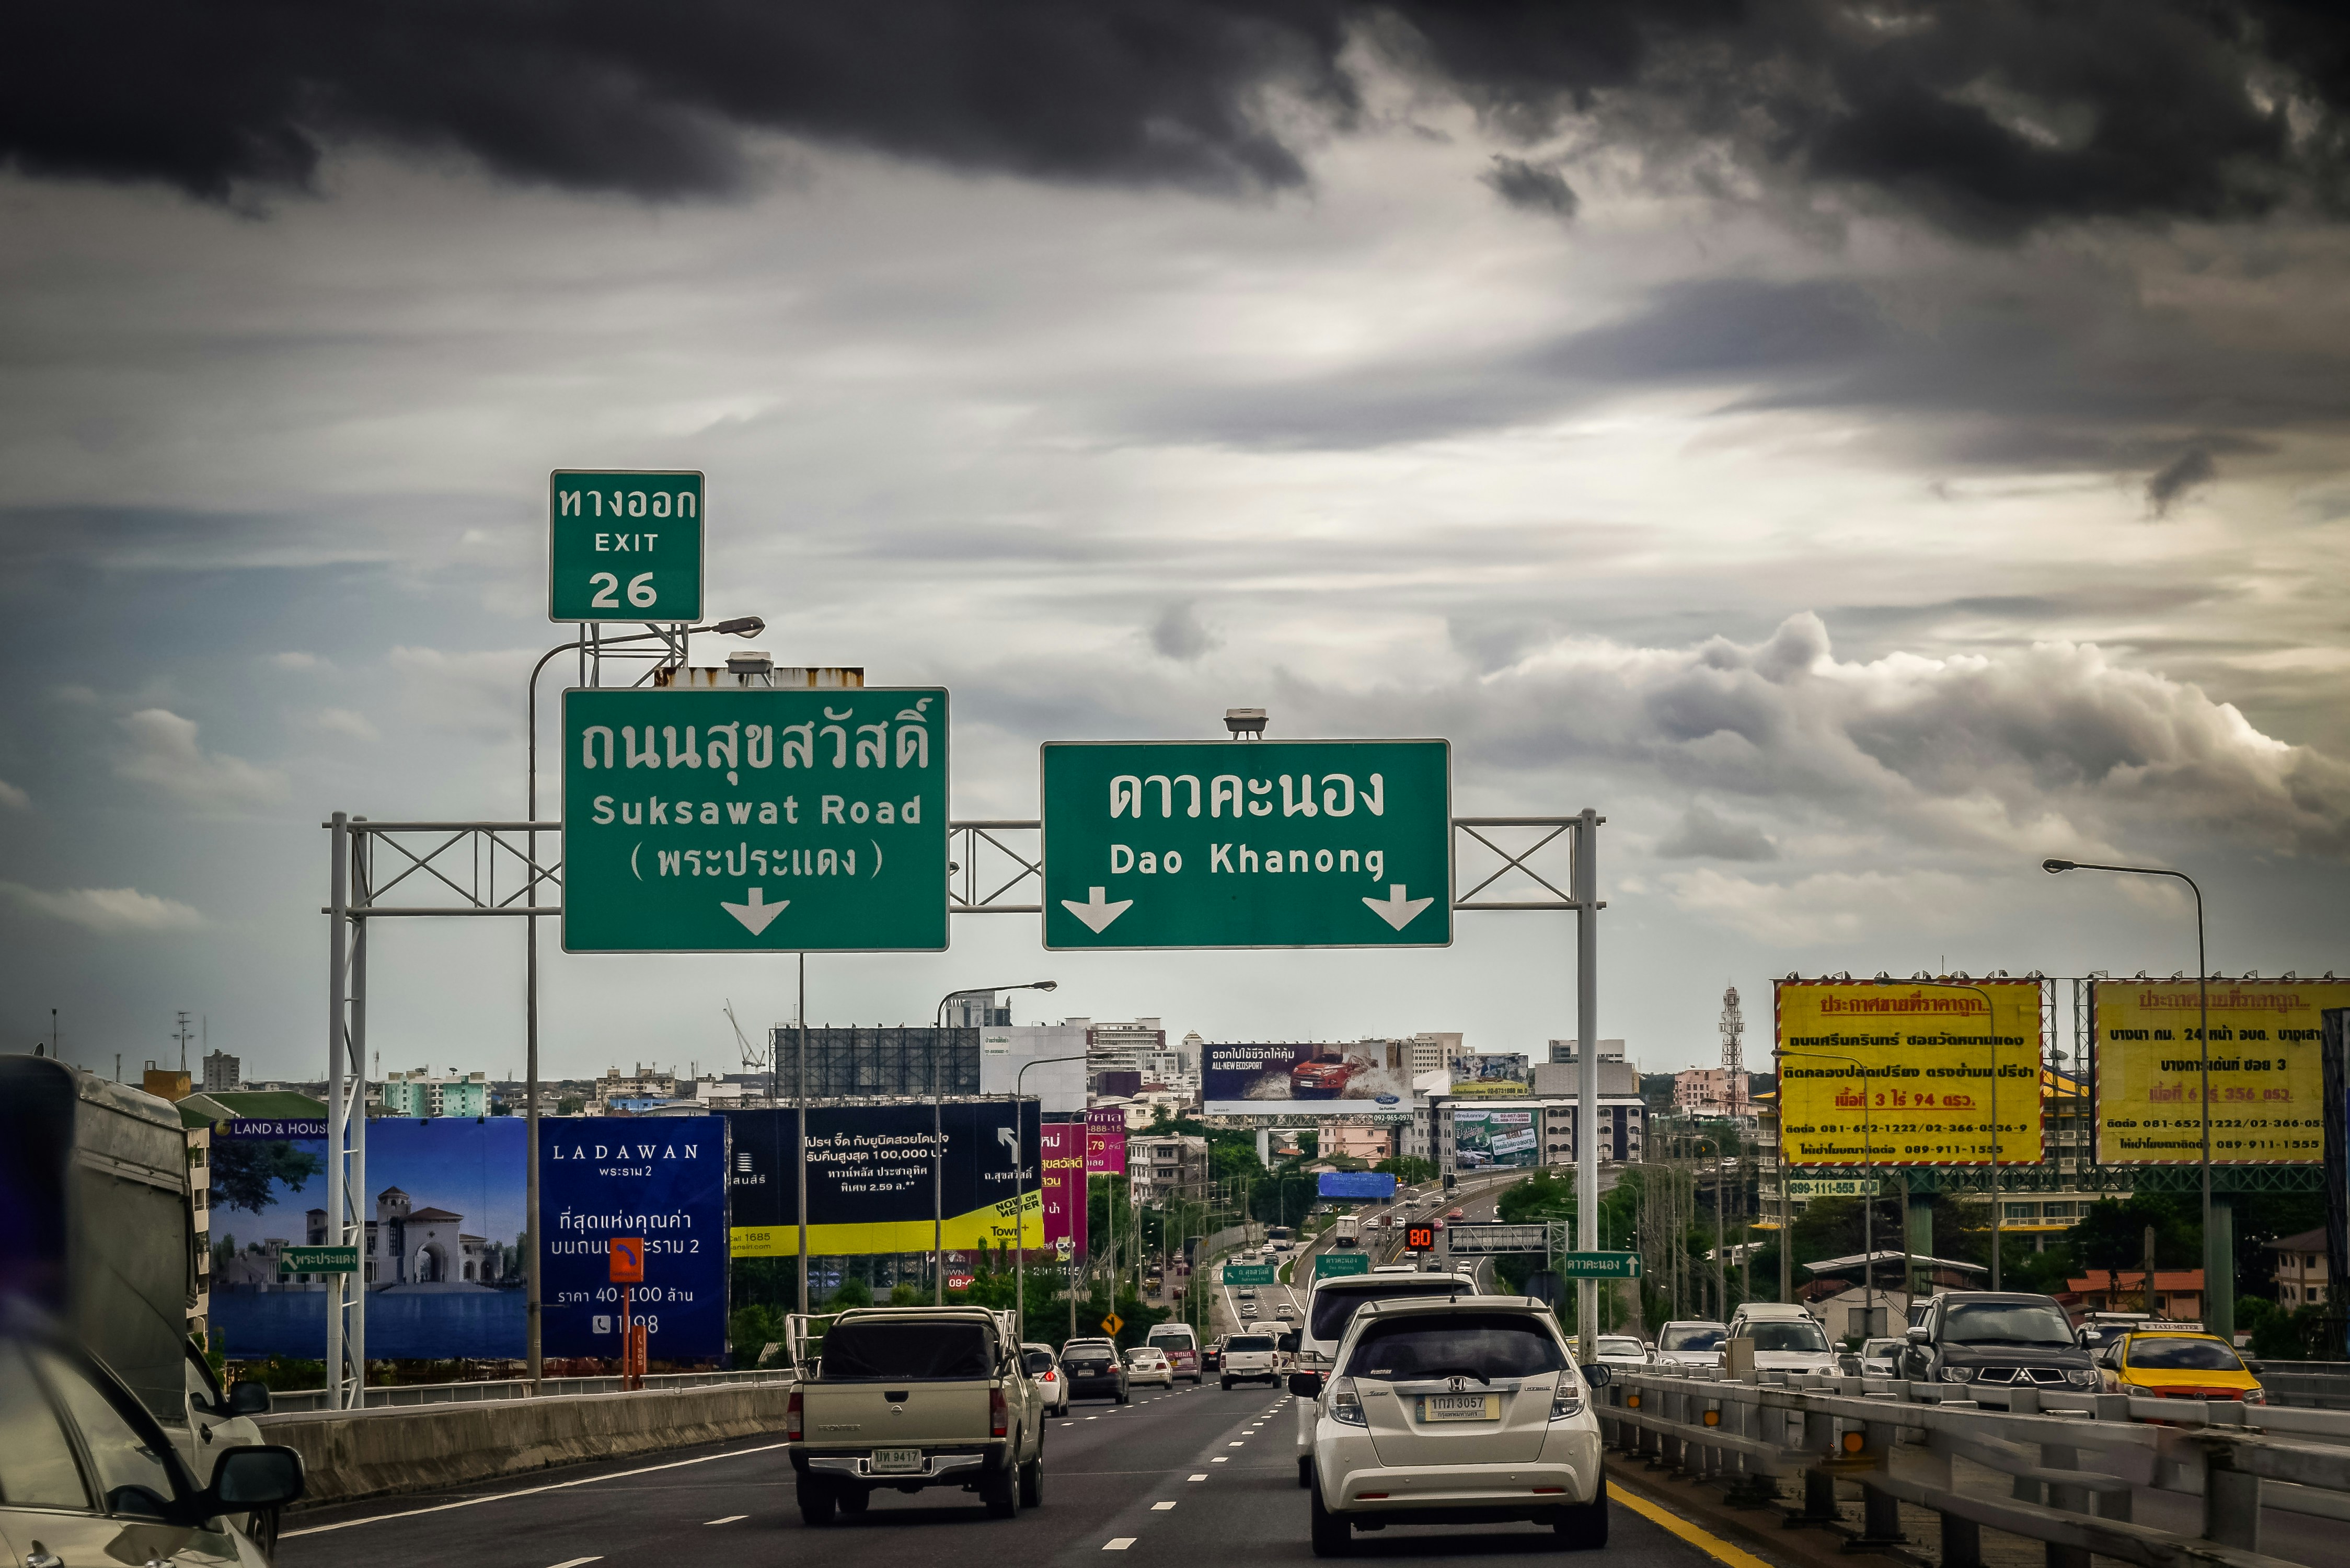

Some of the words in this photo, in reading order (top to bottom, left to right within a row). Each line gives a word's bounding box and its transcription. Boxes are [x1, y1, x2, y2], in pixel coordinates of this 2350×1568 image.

[559, 489, 696, 518] ทางออก
[595, 533, 659, 552] EXIT
[589, 571, 658, 608] 26
[582, 697, 934, 786] ถนนสุขสวัสดิ์
[1110, 773, 1384, 818] ดาวคะนอง
[591, 795, 799, 825] Suksawat
[822, 794, 921, 825] Road
[1110, 844, 1183, 874] Dao
[1211, 844, 1384, 882] Khanong
[2110, 1029, 2149, 1041] บางนา
[2154, 1029, 2175, 1041] กม.
[2184, 1028, 2202, 1041] 24
[2208, 1024, 2233, 1041] หน้า
[2239, 1029, 2270, 1041] อบต.
[2278, 1029, 2322, 1042] บางเสา
[1212, 1047, 1295, 1062] ออกไปใช้ชีวิตให้คุ้ม
[1236, 1062, 1263, 1070] ECOSPORT
[2244, 1059, 2271, 1071] ซอย
[2277, 1058, 2287, 1070] 3
[1875, 1093, 1885, 1106] 3
[1891, 1089, 1907, 1106] ไร่
[1914, 1093, 1935, 1106] 94
[2188, 1087, 2197, 1101] 6
[2225, 1087, 2255, 1100] 356
[235, 1123, 272, 1134] LAND
[275, 1123, 284, 1134] &
[289, 1123, 329, 1134] HOUS
[1785, 1124, 1816, 1134] ติดต่อ
[2106, 1118, 2137, 1128] ติดต่อ
[2216, 1140, 2320, 1149] 089-911-1555
[553, 1145, 698, 1159] LADAWAN
[807, 1151, 869, 1164] รับคืนสูงสุด
[873, 1149, 928, 1160] 100,000
[600, 1167, 642, 1177] พระราม
[646, 1166, 652, 1176] 2
[877, 1165, 927, 1178] ประชาอุทิศ
[1025, 1194, 1038, 1202] OR
[560, 1206, 691, 1235] ที่สุดแห่งคุณค่า
[745, 1232, 770, 1241] 1685
[690, 1239, 699, 1253] 2
[295, 1252, 357, 1266] พระประแดง
[1568, 1259, 1620, 1271] ดาวคะนอง
[558, 1292, 589, 1303] ราคา
[667, 1289, 694, 1302] ล้าน
[1457, 1397, 1484, 1409] 3057
[893, 1451, 918, 1462] 9417
